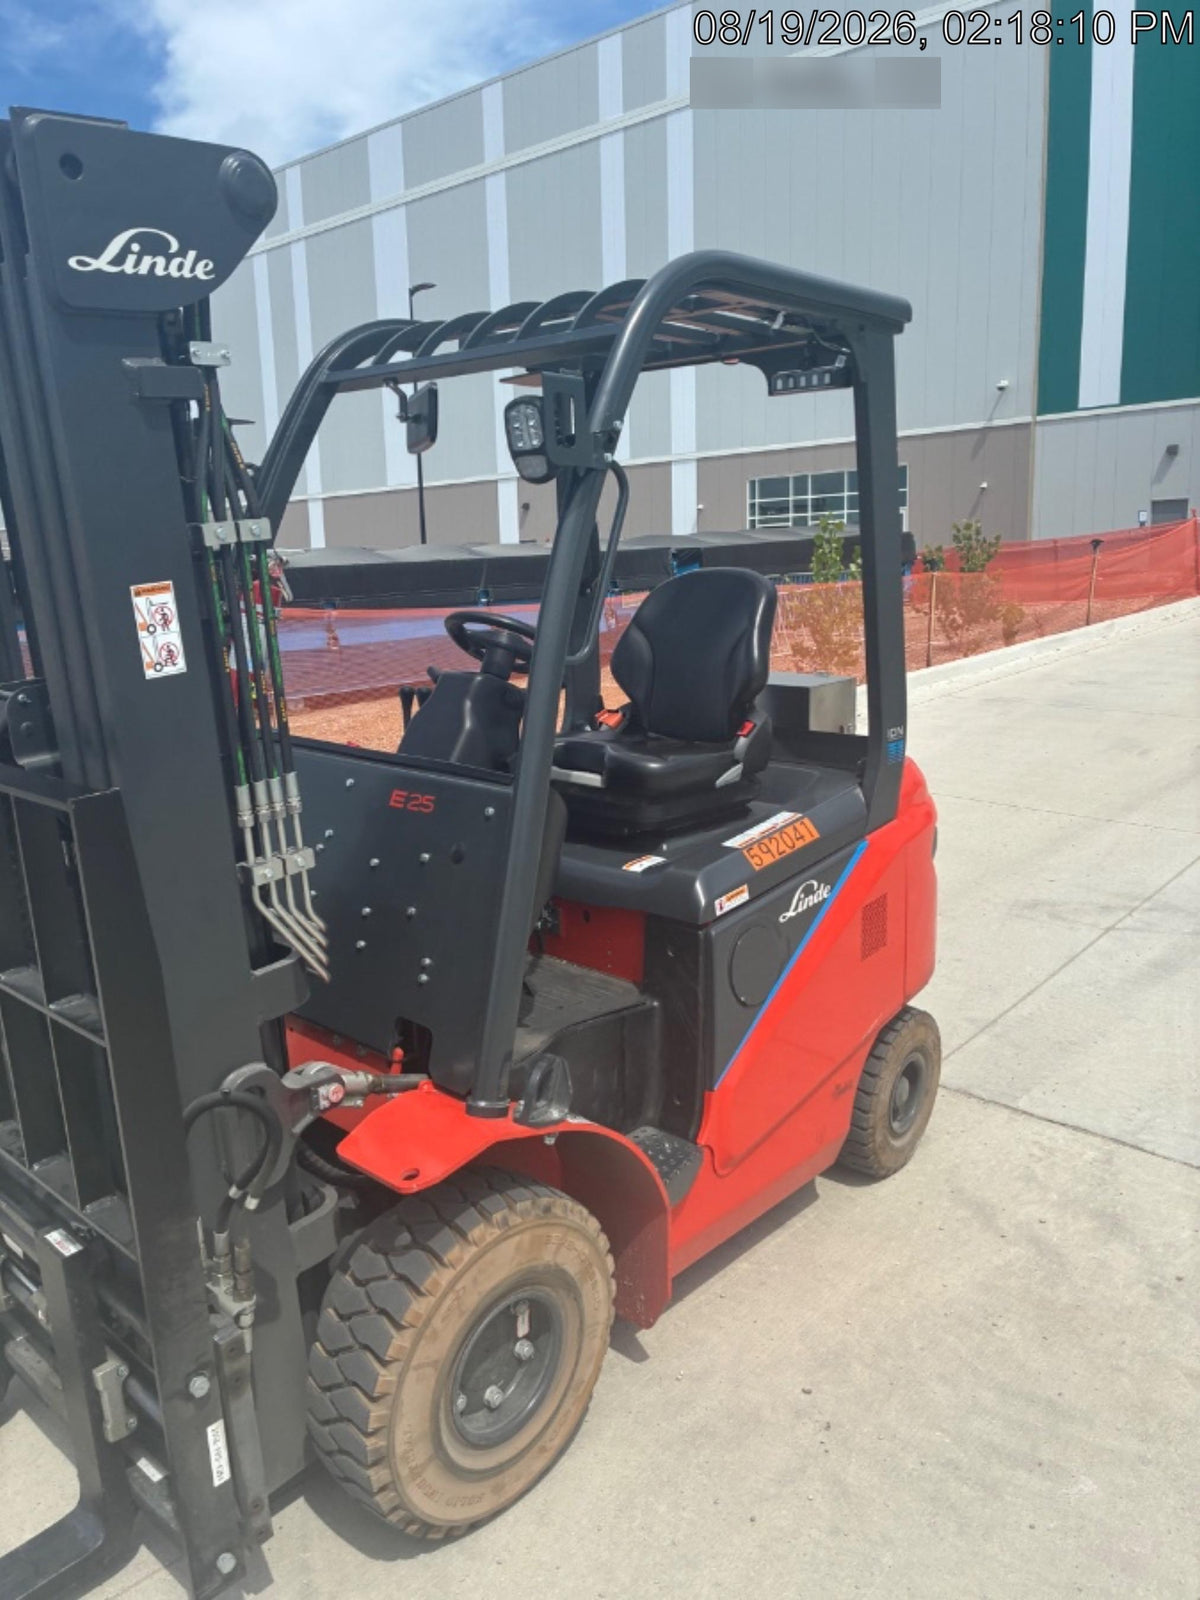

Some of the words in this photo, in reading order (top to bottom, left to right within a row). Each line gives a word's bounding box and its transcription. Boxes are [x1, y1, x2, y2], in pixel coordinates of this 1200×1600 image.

[67, 227, 215, 280] Linde
[389, 788, 436, 814] E25
[746, 819, 817, 867] 592041
[778, 880, 832, 923] Linde
